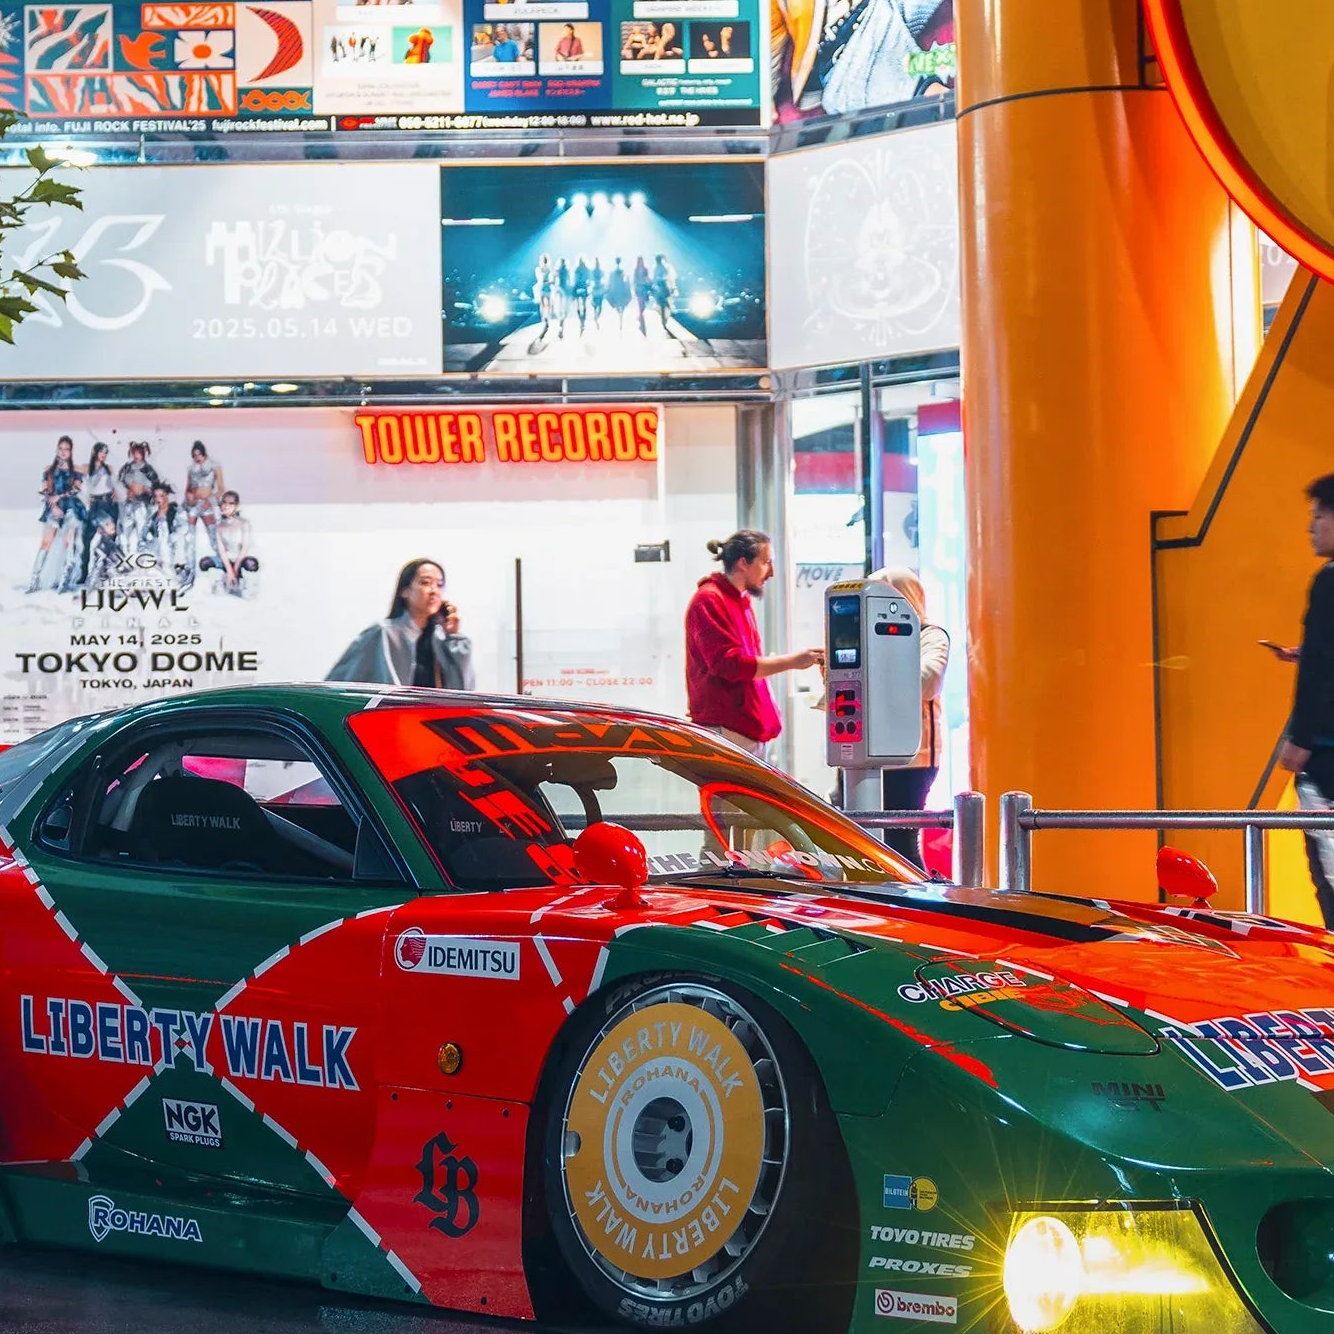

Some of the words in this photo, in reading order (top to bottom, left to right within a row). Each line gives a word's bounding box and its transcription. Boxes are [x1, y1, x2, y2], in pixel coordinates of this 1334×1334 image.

[5, 121, 32, 133] otal
[35, 121, 61, 132] info.
[64, 120, 91, 132] FUJI
[94, 120, 129, 132] ROCK
[212, 118, 328, 133] fujirockfestival.com
[192, 318, 338, 339] 2025.05.14
[349, 318, 413, 337] WED
[355, 411, 486, 464] TOWER
[492, 410, 659, 463] RECORDS
[114, 553, 157, 569] XG
[131, 578, 172, 588] FIRST
[797, 566, 843, 582] MOVE
[70, 633, 110, 646] MAY
[118, 633, 144, 648] 14,
[151, 633, 202, 646] 2025
[15, 652, 138, 673] TOKYO
[151, 650, 258, 672] DOME
[80, 678, 137, 690] TOKYO,
[142, 677, 193, 689] JAPAN
[523, 678, 543, 687] PEN
[171, 814, 207, 827] LIBERTY
[209, 816, 241, 829] WALK
[450, 818, 482, 833] LIBERTY
[427, 945, 517, 974] IDEMITSU
[897, 971, 1027, 1003] CHARGE
[20, 995, 215, 1074] LIBERTY
[220, 1014, 361, 1092] WALK
[589, 1021, 681, 1104] LIBERTY
[689, 1025, 744, 1099] WALK
[621, 1065, 700, 1107] ROHANA
[1091, 1081, 1166, 1098] MINI
[167, 1102, 221, 1137] NGK
[169, 1132, 194, 1143] SPARK
[195, 1136, 220, 1148] PLUGS
[624, 1173, 707, 1214] ROHANA
[90, 1198, 203, 1242] ROHANA
[584, 1179, 637, 1254] WALK
[642, 1177, 741, 1260] LIBERTY
[870, 1225, 919, 1245] TOYO
[921, 1231, 976, 1251] TIRES
[868, 1256, 973, 1278] PROXES
[687, 1274, 749, 1323] TOYO
[897, 1297, 955, 1317] brembo
[618, 1297, 683, 1327] TIRES
